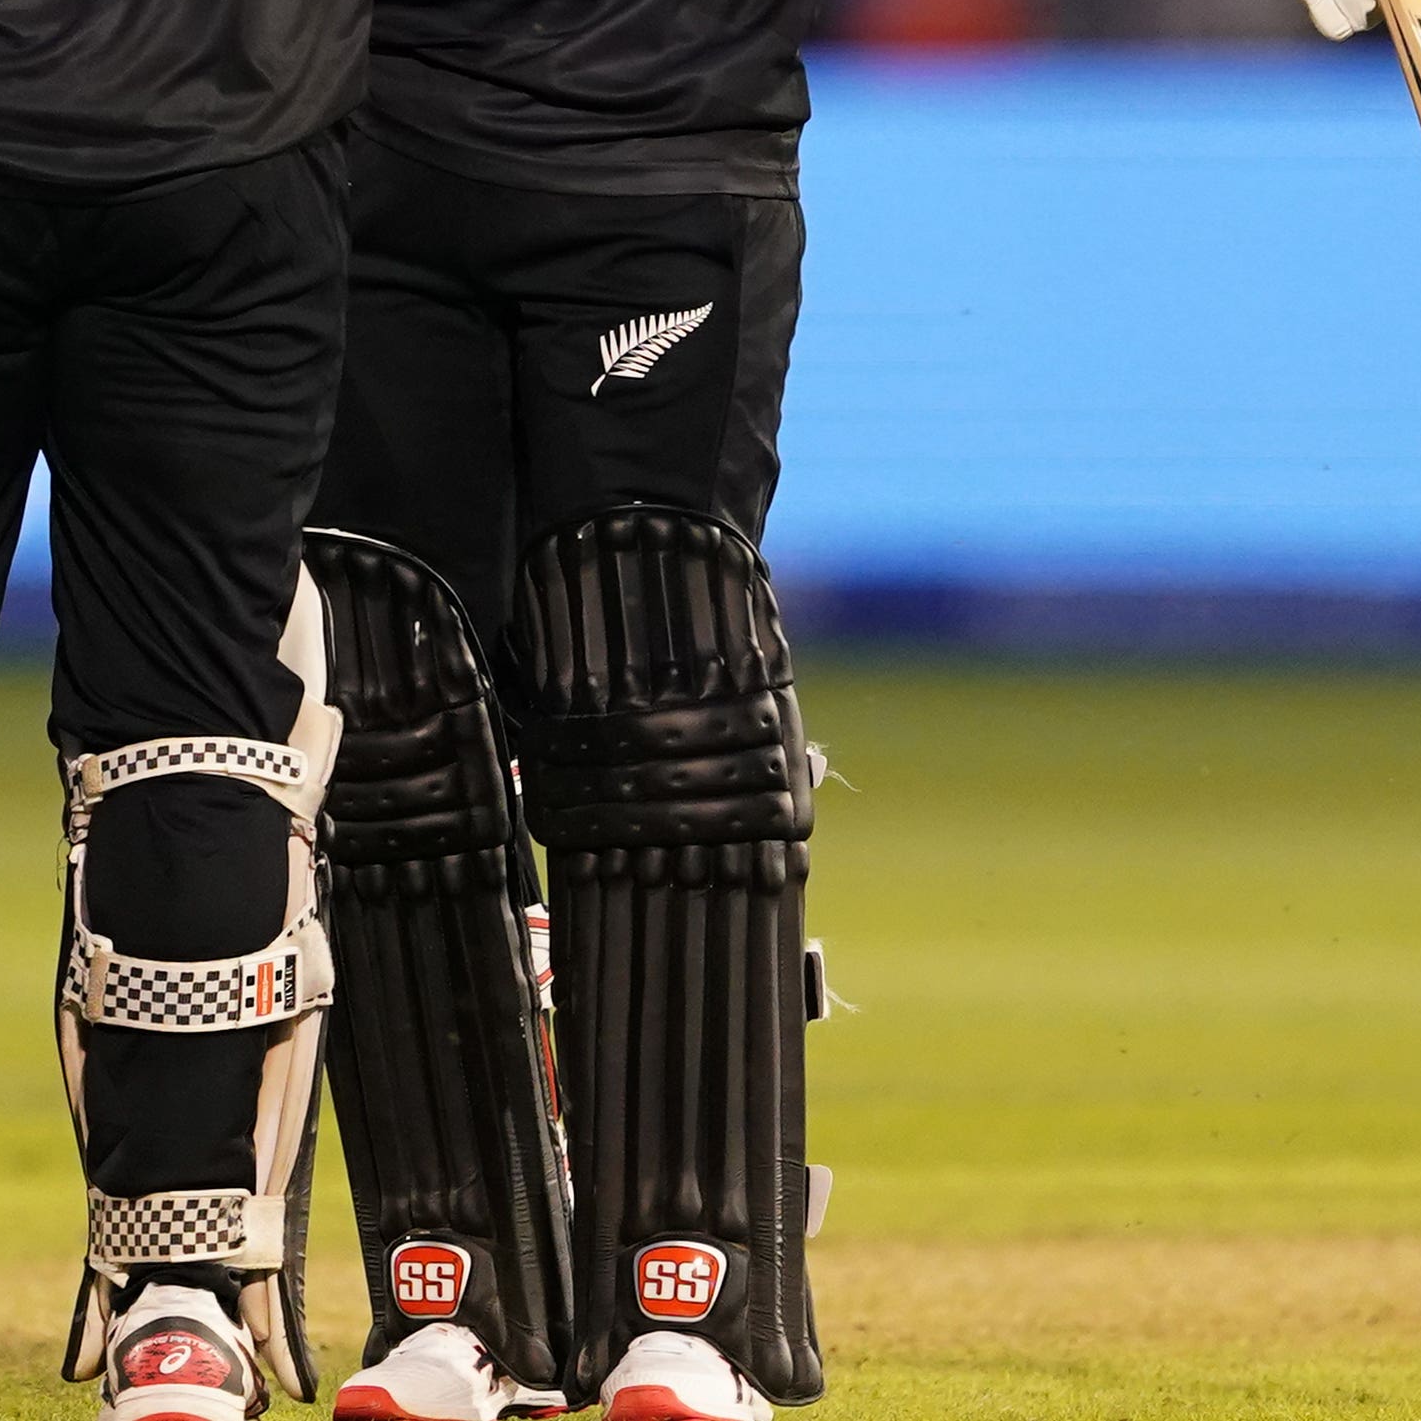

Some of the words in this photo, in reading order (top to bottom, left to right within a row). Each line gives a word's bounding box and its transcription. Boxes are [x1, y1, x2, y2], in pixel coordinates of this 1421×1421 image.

[285, 965, 294, 1007] SILVER
[399, 1262, 456, 1302] SS
[643, 1260, 711, 1303] SS
